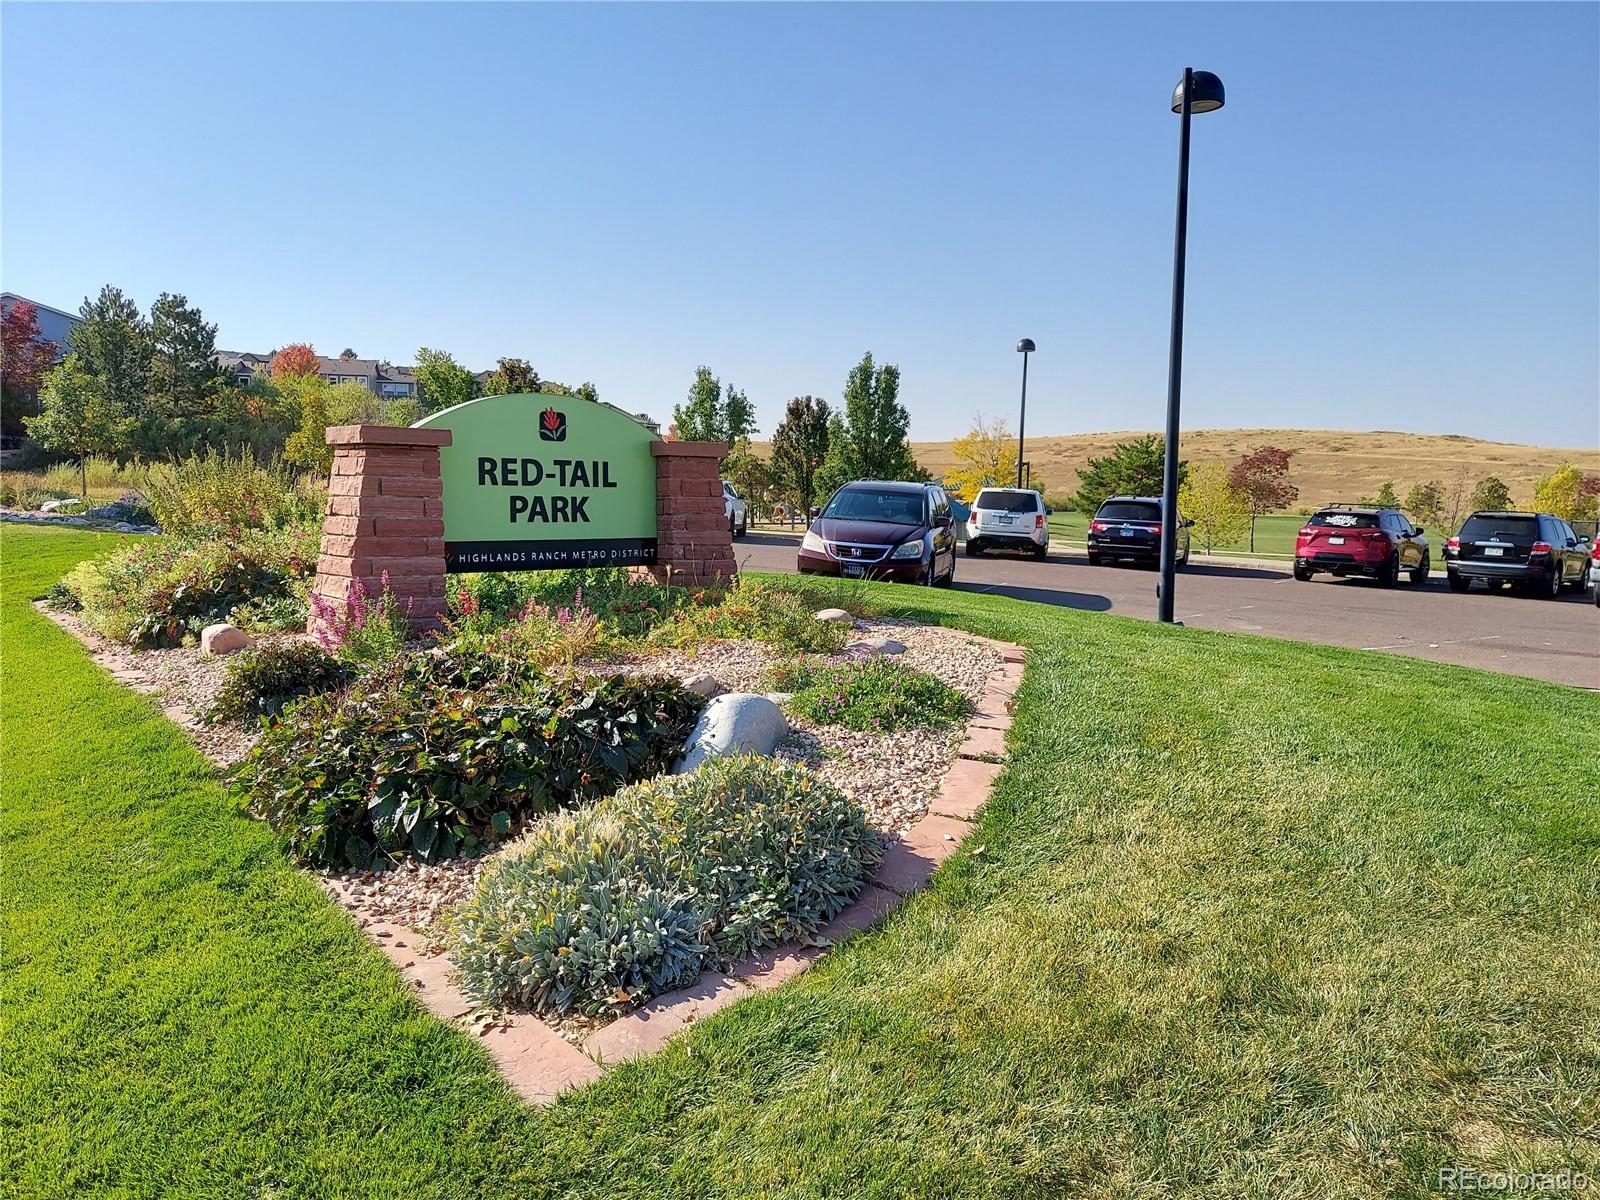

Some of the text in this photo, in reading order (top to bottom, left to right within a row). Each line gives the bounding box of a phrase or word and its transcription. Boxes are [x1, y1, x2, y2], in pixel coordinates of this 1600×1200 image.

[478, 457, 617, 488] RED-TAIL
[509, 495, 590, 523] PARK
[459, 548, 655, 563] HIGHLANDS RANCH METRO DISTRICT
